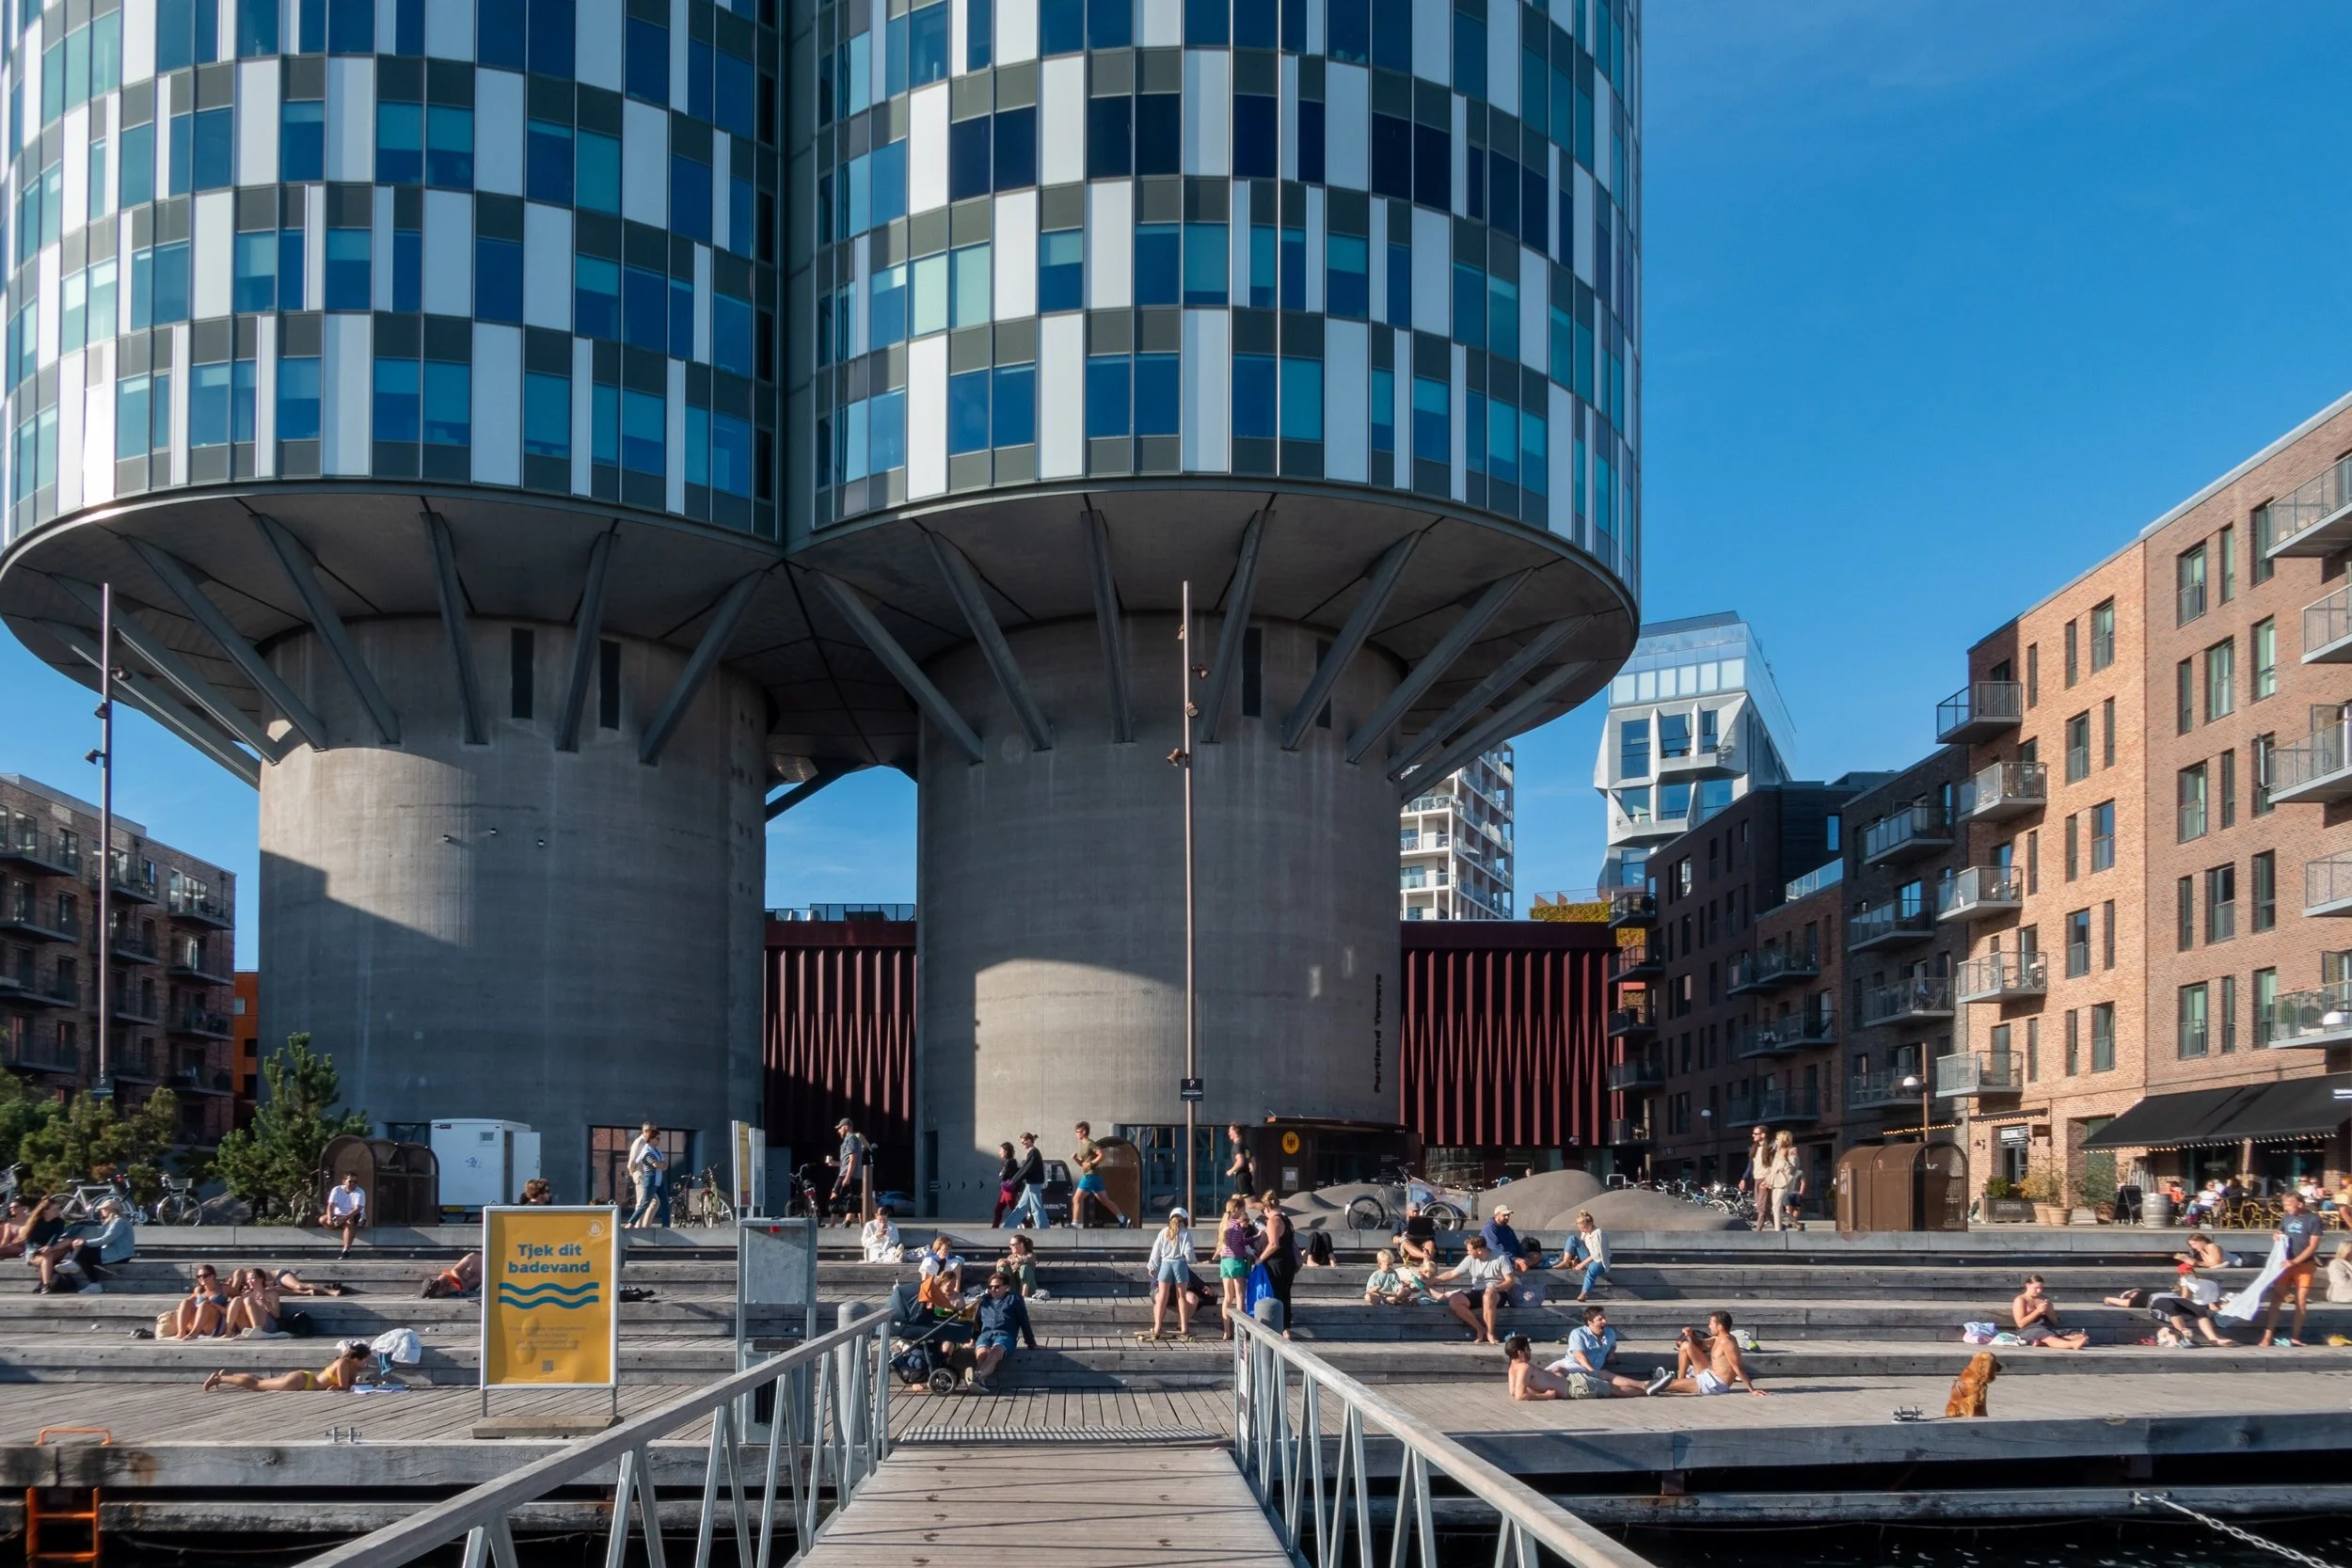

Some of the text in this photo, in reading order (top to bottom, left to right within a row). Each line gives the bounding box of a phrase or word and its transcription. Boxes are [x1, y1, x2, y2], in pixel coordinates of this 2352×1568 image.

[517, 1243, 582, 1259] Tjek dit
[508, 1260, 591, 1274] badevand
